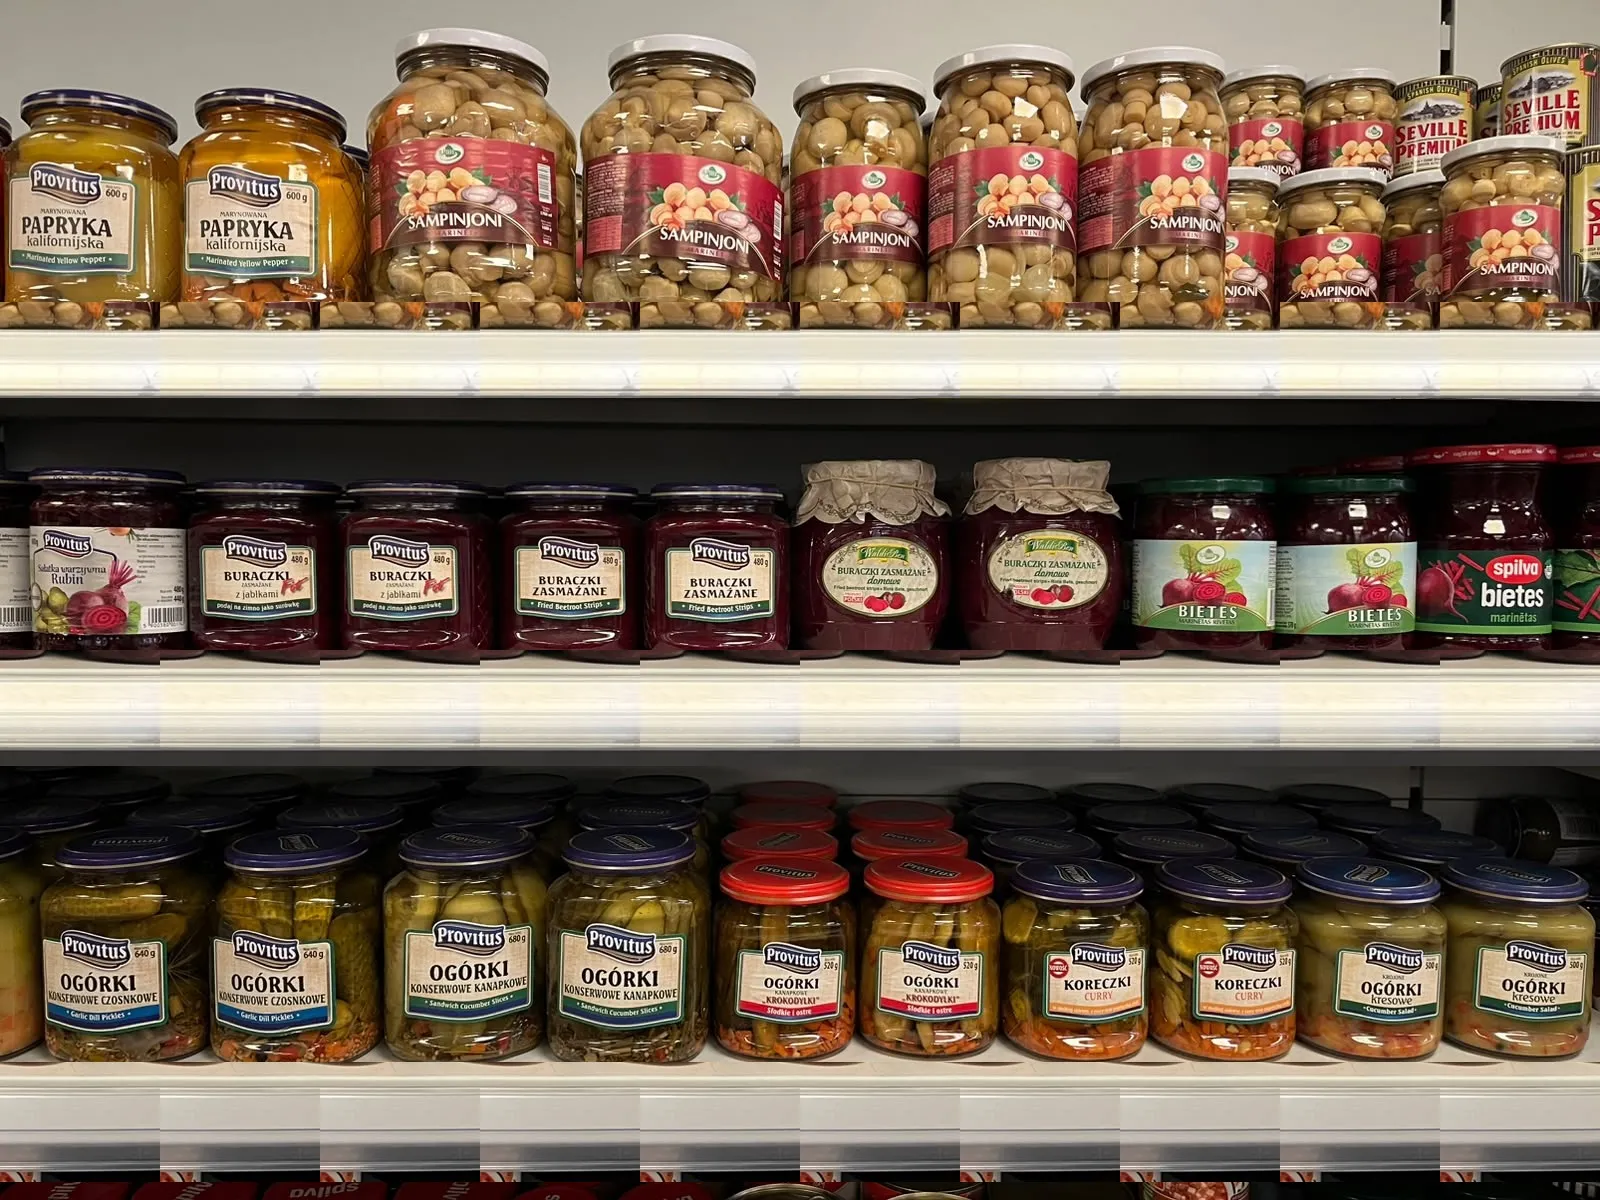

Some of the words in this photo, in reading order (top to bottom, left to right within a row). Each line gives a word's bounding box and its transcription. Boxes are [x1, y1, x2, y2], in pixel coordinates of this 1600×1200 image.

[1512, 58, 1538, 75] SPANISH
[1541, 56, 1566, 64] OLIVES
[1407, 86, 1434, 100] SPANISH
[1436, 85, 1458, 94] OLIVES
[1504, 90, 1580, 123] SEVILLE
[1395, 120, 1468, 145] SEVILLE
[32, 169, 98, 196] Provitus
[212, 172, 278, 198] Provitus
[106, 188, 120, 198] 600
[286, 191, 300, 200] 600
[40, 208, 86, 216] MARYNOWANA
[22, 216, 112, 238] PAPRYKA
[200, 219, 294, 240] PAPRYKA
[27, 235, 104, 250] kalifornijska
[206, 238, 286, 252] kalifornijska
[26, 252, 56, 264] Marinated
[57, 256, 78, 264] Yellow
[80, 256, 106, 264] Pepper
[206, 256, 238, 266] Marinated
[239, 260, 260, 268] Yellow
[263, 258, 288, 267] Pepper
[44, 534, 89, 550] Provitus
[227, 542, 284, 560] Provitus
[372, 542, 428, 560] Provitus
[542, 542, 597, 561] Provitus
[694, 544, 748, 562] Provitus
[1004, 560, 1047, 568] BURACZKI
[1493, 559, 1538, 578] spilva
[52, 573, 83, 584] Rubin
[224, 571, 290, 580] BURACZKI
[370, 571, 432, 580] BURACZKI
[838, 567, 879, 576] BURACZKI
[539, 576, 600, 584] BURACZKI
[690, 578, 752, 588] BURACZKI
[867, 576, 901, 584] domowe
[1481, 582, 1544, 608] bietes
[216, 602, 232, 610] podaj
[262, 603, 275, 612] jako
[538, 602, 554, 610] Fried
[556, 602, 582, 610] Beetroot
[584, 602, 603, 610] Strips
[689, 604, 705, 612] Fried
[735, 604, 754, 612] Strips
[1179, 604, 1237, 618] BIETES
[1348, 608, 1401, 622] BIETES
[1490, 612, 1537, 622] marinētas
[758, 865, 814, 878] Provitus
[904, 862, 954, 878] Provitus
[438, 927, 502, 946] Provitus
[508, 934, 520, 943] 680
[590, 930, 653, 954] Provitus
[64, 936, 128, 959] Provitus
[134, 950, 149, 958] 640
[236, 936, 296, 960] Provitus
[303, 950, 317, 958] 640
[658, 946, 671, 954] 680
[767, 948, 818, 967] Provitus
[905, 946, 958, 966] Provitus
[1074, 948, 1124, 964] Provitus
[1225, 948, 1274, 964] Provitus
[1368, 948, 1420, 967] Provitus
[1510, 946, 1564, 966] Provitus
[430, 960, 508, 981] OGÓRKI
[963, 962, 974, 970] 520
[1569, 961, 1579, 969] 500
[60, 972, 136, 992] OGÓRKI
[231, 972, 304, 993] OGÓRKI
[582, 966, 658, 988] OGÓRKI
[764, 976, 819, 990] OGÓRKI
[904, 974, 959, 988] OGÓRKI
[1064, 976, 1131, 990] KORECZKI
[1215, 976, 1282, 990] KORECZKI
[410, 984, 471, 994] KONSERWOWE
[474, 976, 527, 992] KANAPKOWE
[564, 984, 620, 1000] KONSERWOWE
[624, 989, 678, 1000] KANAPKOWE
[1362, 980, 1422, 996] OGÓRKI
[1502, 978, 1566, 994] OGÓRKI
[48, 990, 98, 1005] KONSERWOWE
[101, 992, 158, 1006] CZOSNKOWE
[220, 990, 268, 1006] KONSERWOWE
[271, 994, 326, 1006] CZOSNKOWE
[1084, 991, 1114, 1000] CURRY
[1235, 991, 1264, 1000] CURRY
[1371, 994, 1412, 1006] kresowe
[1512, 992, 1556, 1004] kresowe
[429, 1000, 459, 1009] Sandwich
[460, 1000, 490, 1010] Cucumber
[492, 996, 509, 1004] Slices
[580, 1002, 608, 1014] Sandwich
[640, 1006, 658, 1014] Slices
[1507, 1002, 1538, 1012] Cucumber
[70, 1011, 88, 1020] Garlic
[101, 1012, 125, 1020] Pickles
[240, 1012, 258, 1022] Garlic
[258, 1014, 270, 1022] Dill
[271, 1013, 294, 1022] Pickles
[1366, 1006, 1396, 1015] Cucumber
[290, 1182, 358, 1198] spilva
